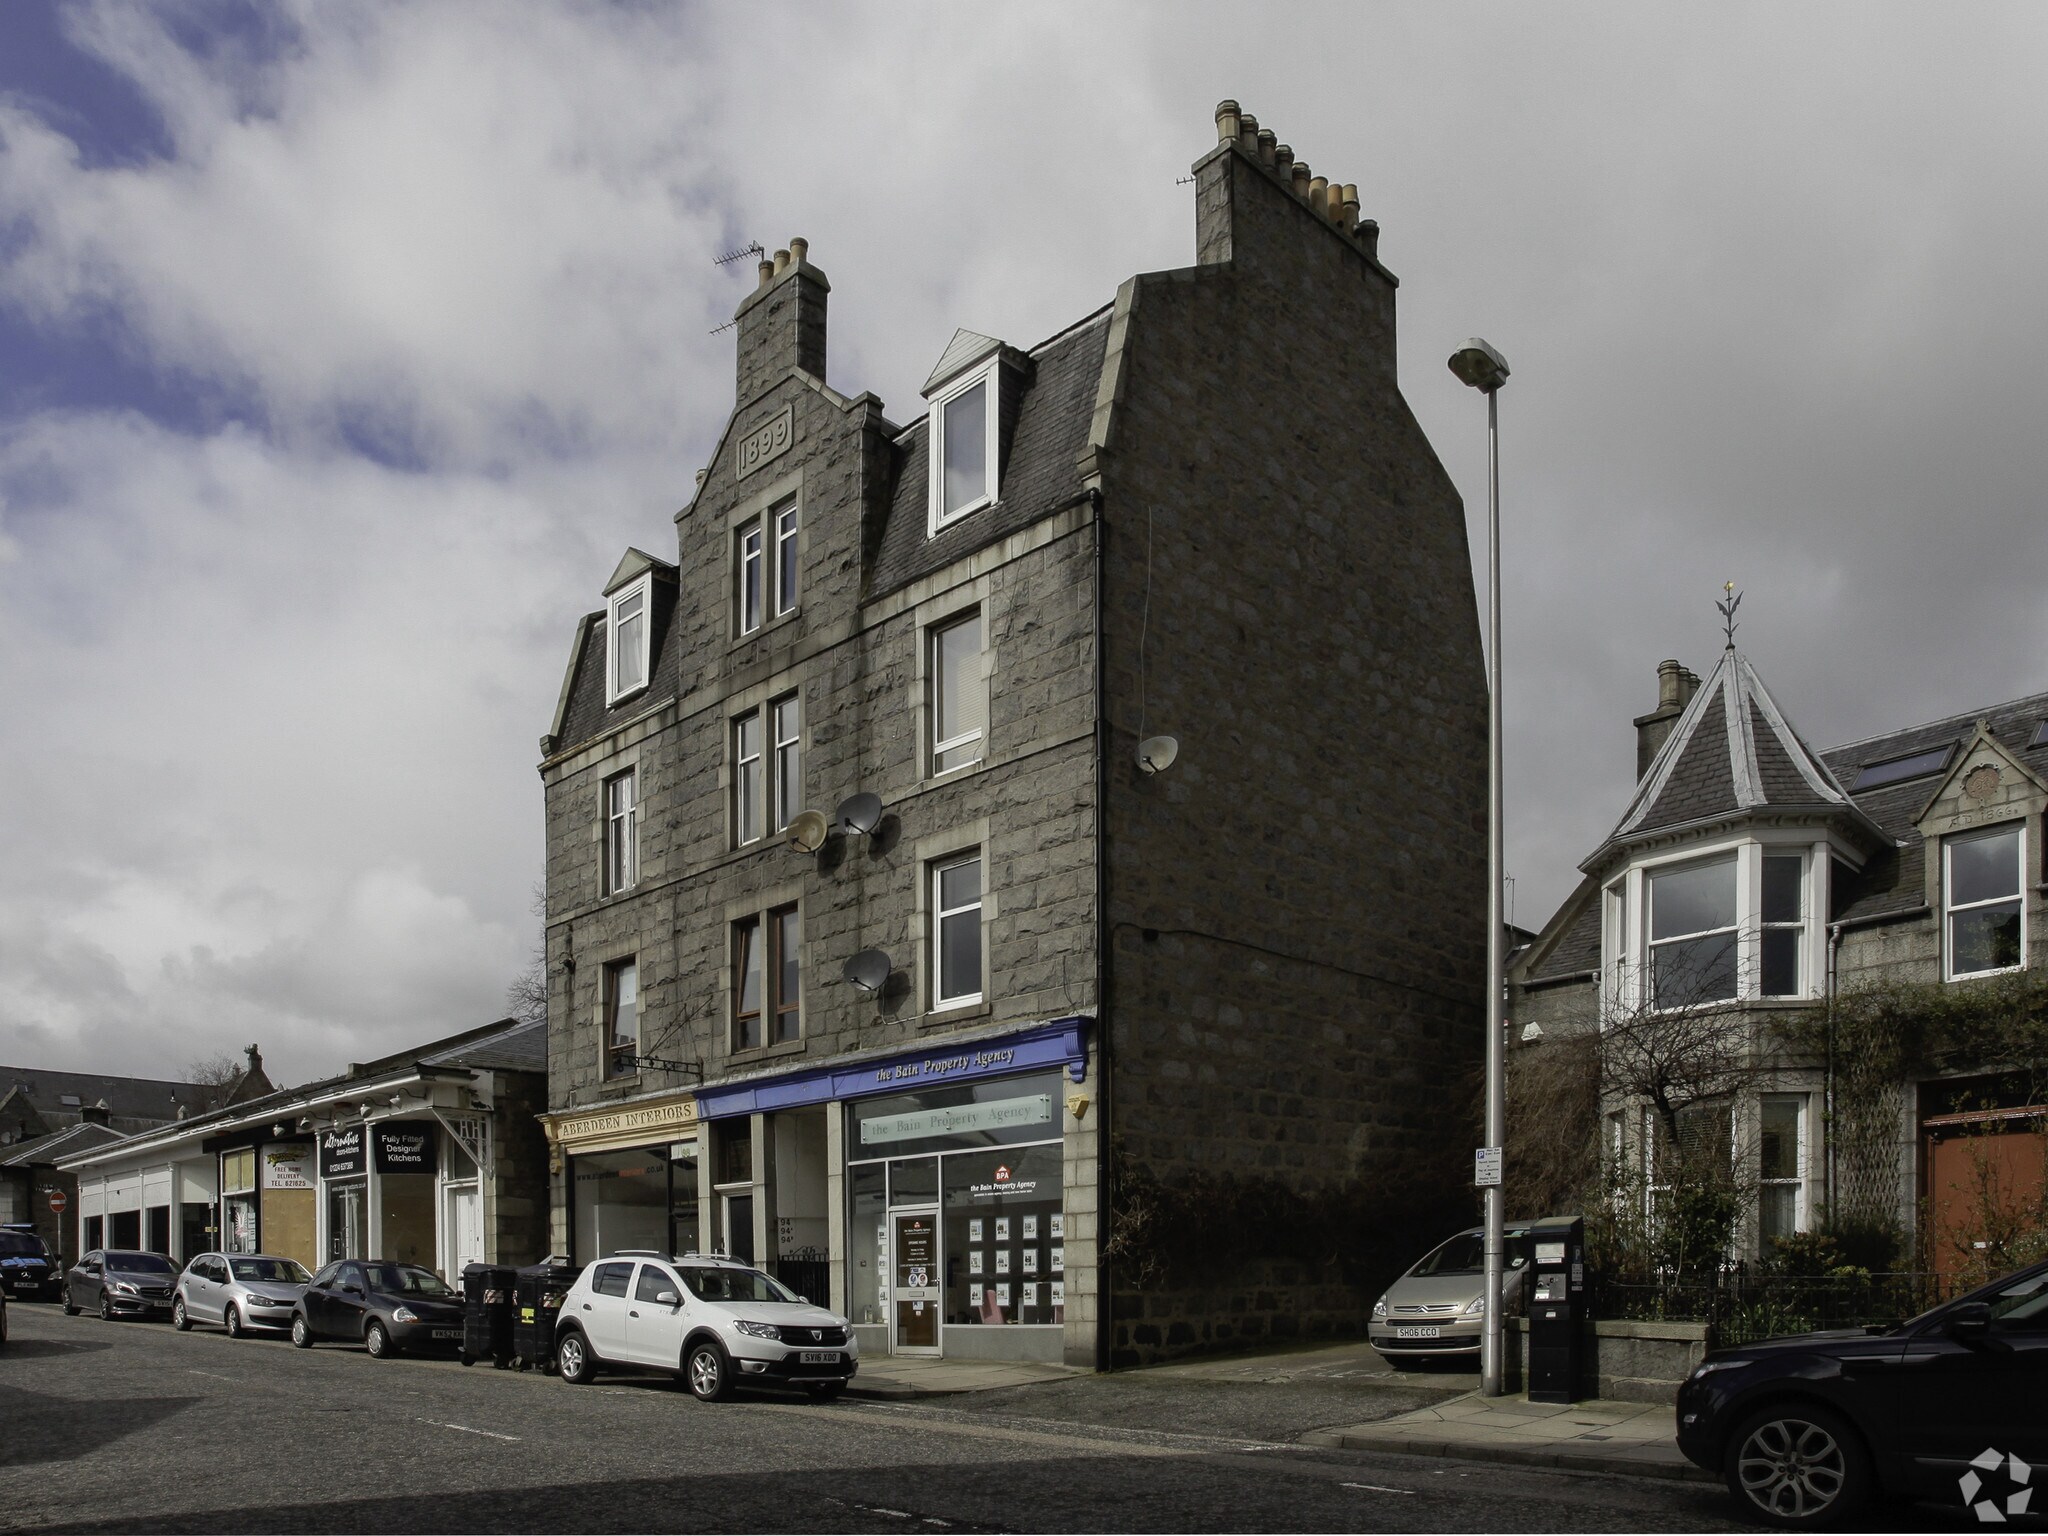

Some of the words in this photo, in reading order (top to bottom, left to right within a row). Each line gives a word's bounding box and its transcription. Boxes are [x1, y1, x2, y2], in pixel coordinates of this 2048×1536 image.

[742, 419, 788, 470] 1899
[876, 1067, 892, 1082] the
[895, 1062, 919, 1079] Bain
[924, 1053, 970, 1074] Property
[973, 1048, 1015, 1069] Agency
[562, 1116, 621, 1137] ABERDEEN
[625, 1104, 692, 1127] INTERIORS
[871, 1122, 889, 1136] the
[896, 1118, 921, 1133] Bain
[929, 1111, 979, 1130] Property
[986, 1104, 1032, 1123] Agency
[381, 1134, 400, 1144] Fully
[402, 1134, 424, 1144] Fitted
[386, 1144, 422, 1154] Designer
[387, 1154, 422, 1163] Kitchens
[996, 1171, 1010, 1180] BPA
[970, 1184, 979, 1192] the
[980, 1183, 993, 1191] Bain
[993, 1181, 1016, 1191] Property
[1017, 1180, 1036, 1189] Agency
[1400, 1327, 1419, 1337] SH06
[805, 1353, 822, 1362] SV16
